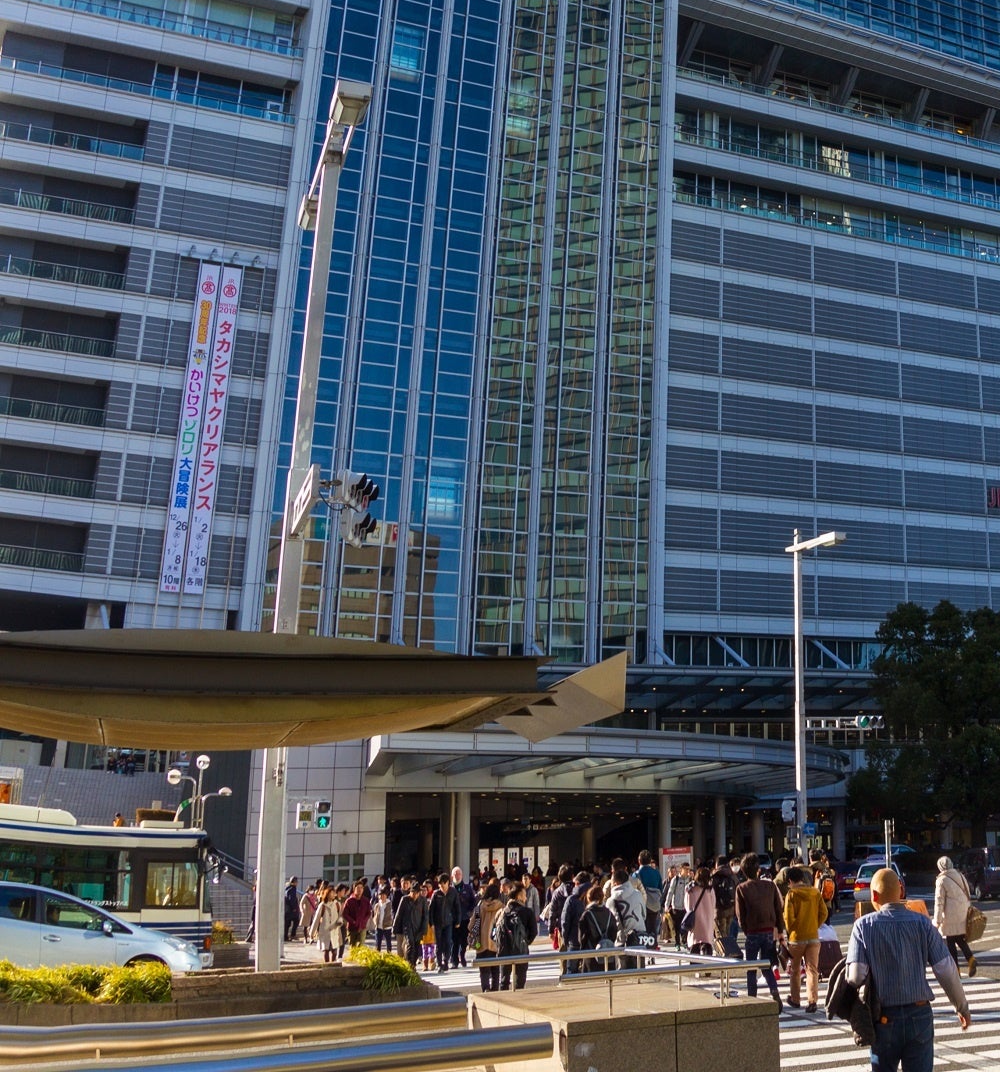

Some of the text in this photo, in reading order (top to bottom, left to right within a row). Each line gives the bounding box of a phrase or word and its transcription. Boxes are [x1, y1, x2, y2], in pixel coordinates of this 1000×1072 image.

[218, 307, 238, 315] 2018
[196, 320, 232, 511] タカシマヤクリアランス
